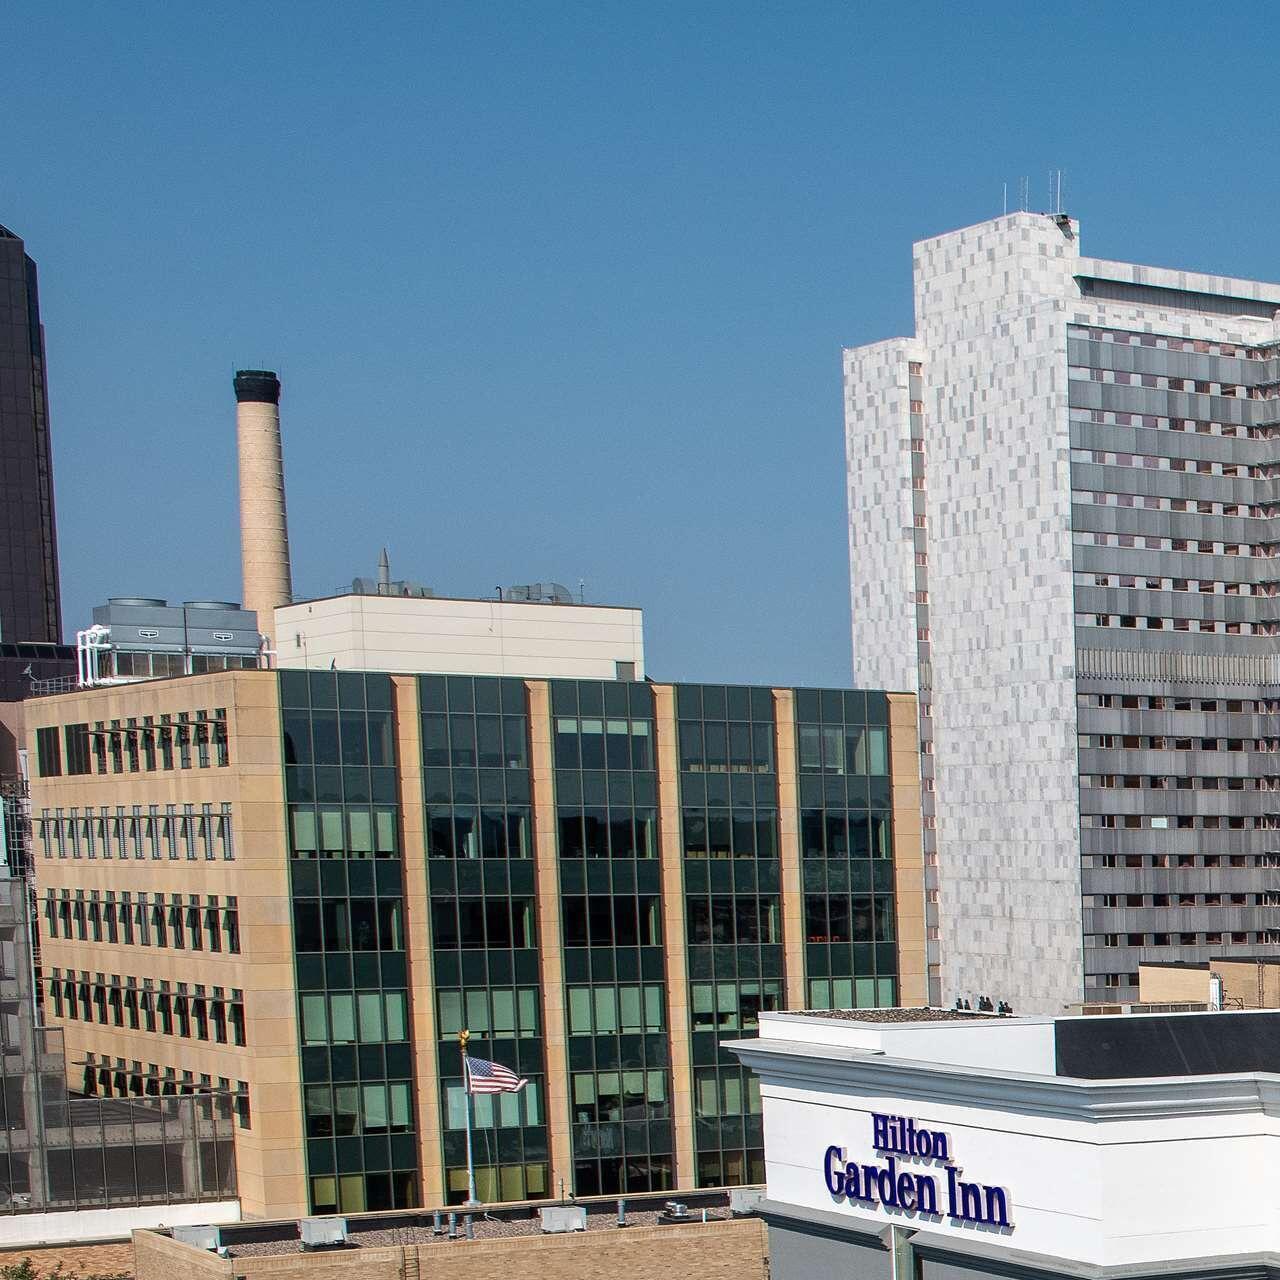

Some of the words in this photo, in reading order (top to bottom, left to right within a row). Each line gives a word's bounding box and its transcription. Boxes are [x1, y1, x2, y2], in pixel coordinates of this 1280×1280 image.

[872, 1112, 950, 1161] Hilton
[824, 1145, 943, 1215] Garden
[944, 1166, 1015, 1227] Inn
